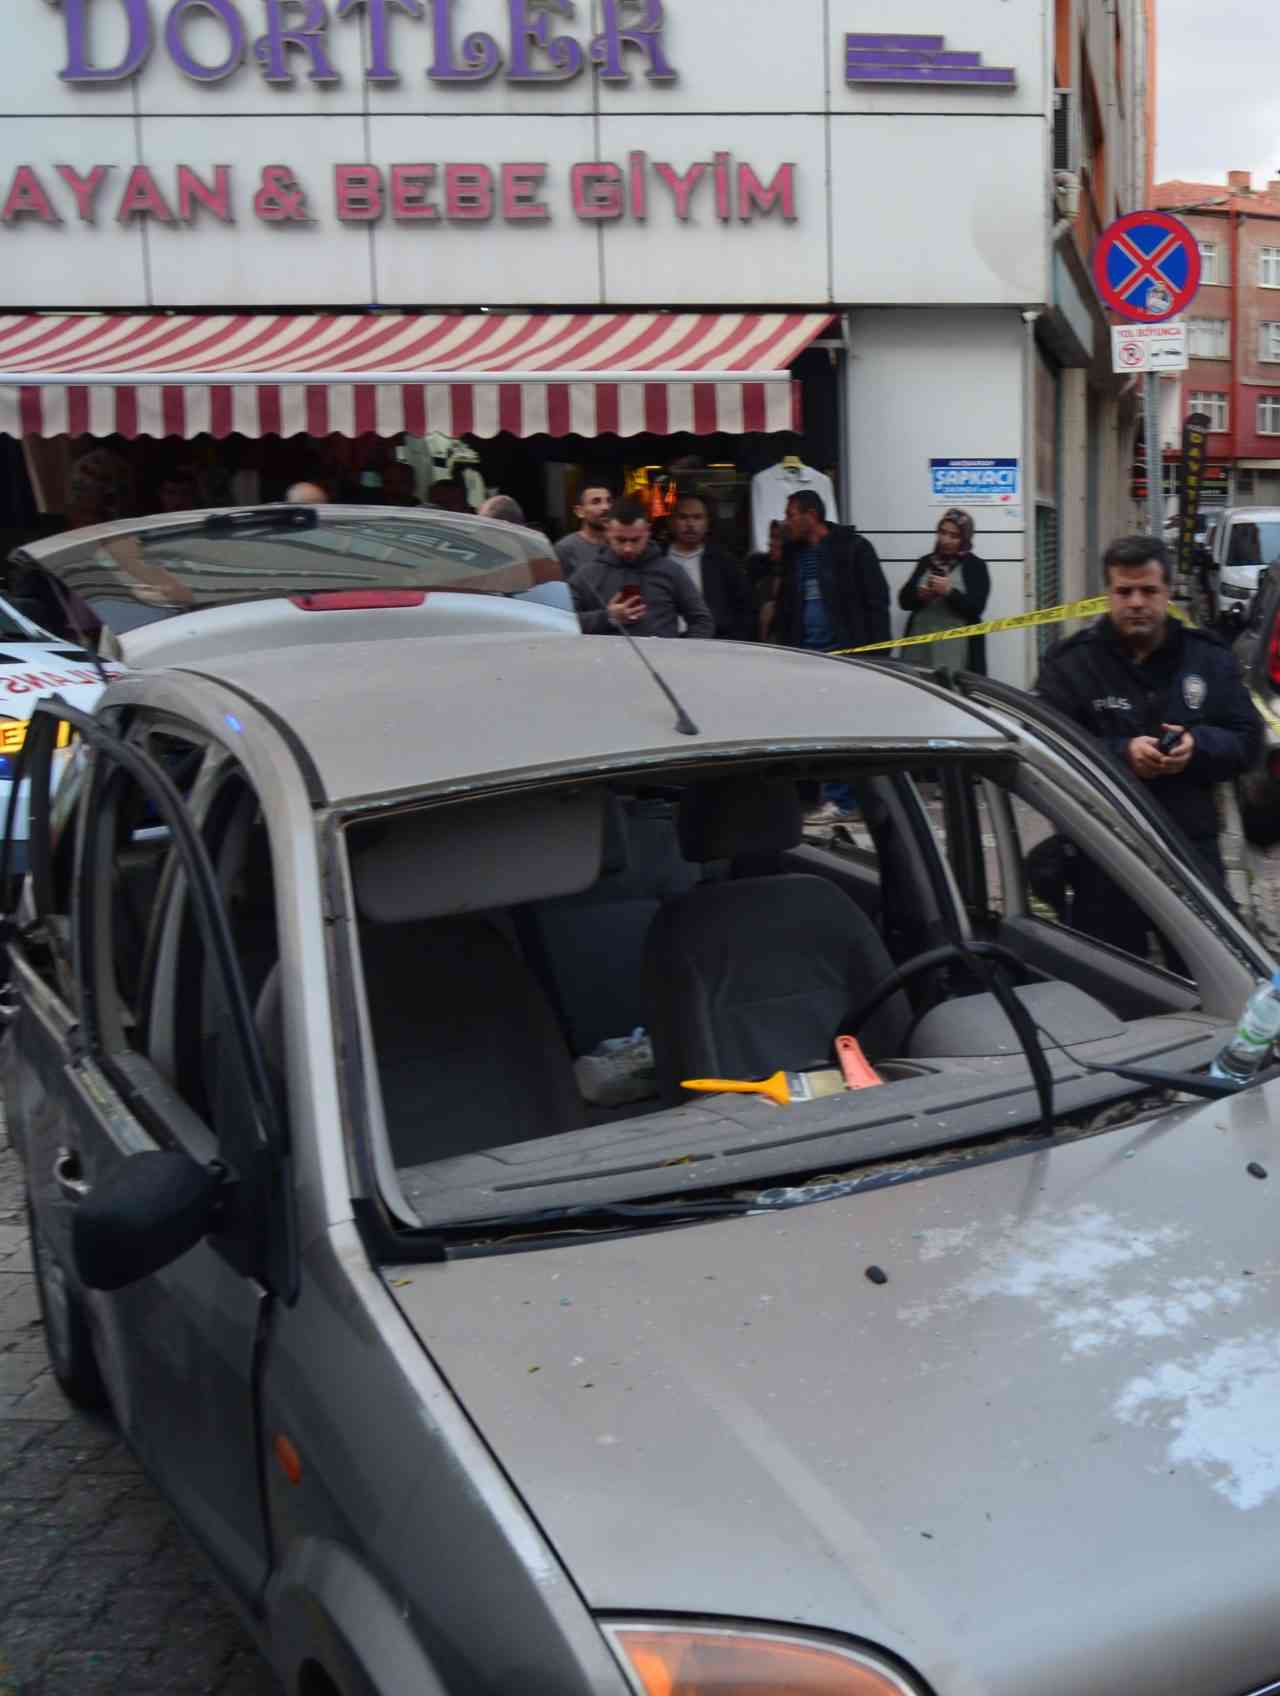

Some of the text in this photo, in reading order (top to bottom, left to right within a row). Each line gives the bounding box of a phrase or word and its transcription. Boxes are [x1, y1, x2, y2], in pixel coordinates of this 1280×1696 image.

[253, 164, 307, 222] &
[333, 162, 550, 222] BEBE
[569, 150, 797, 223] GİYİM
